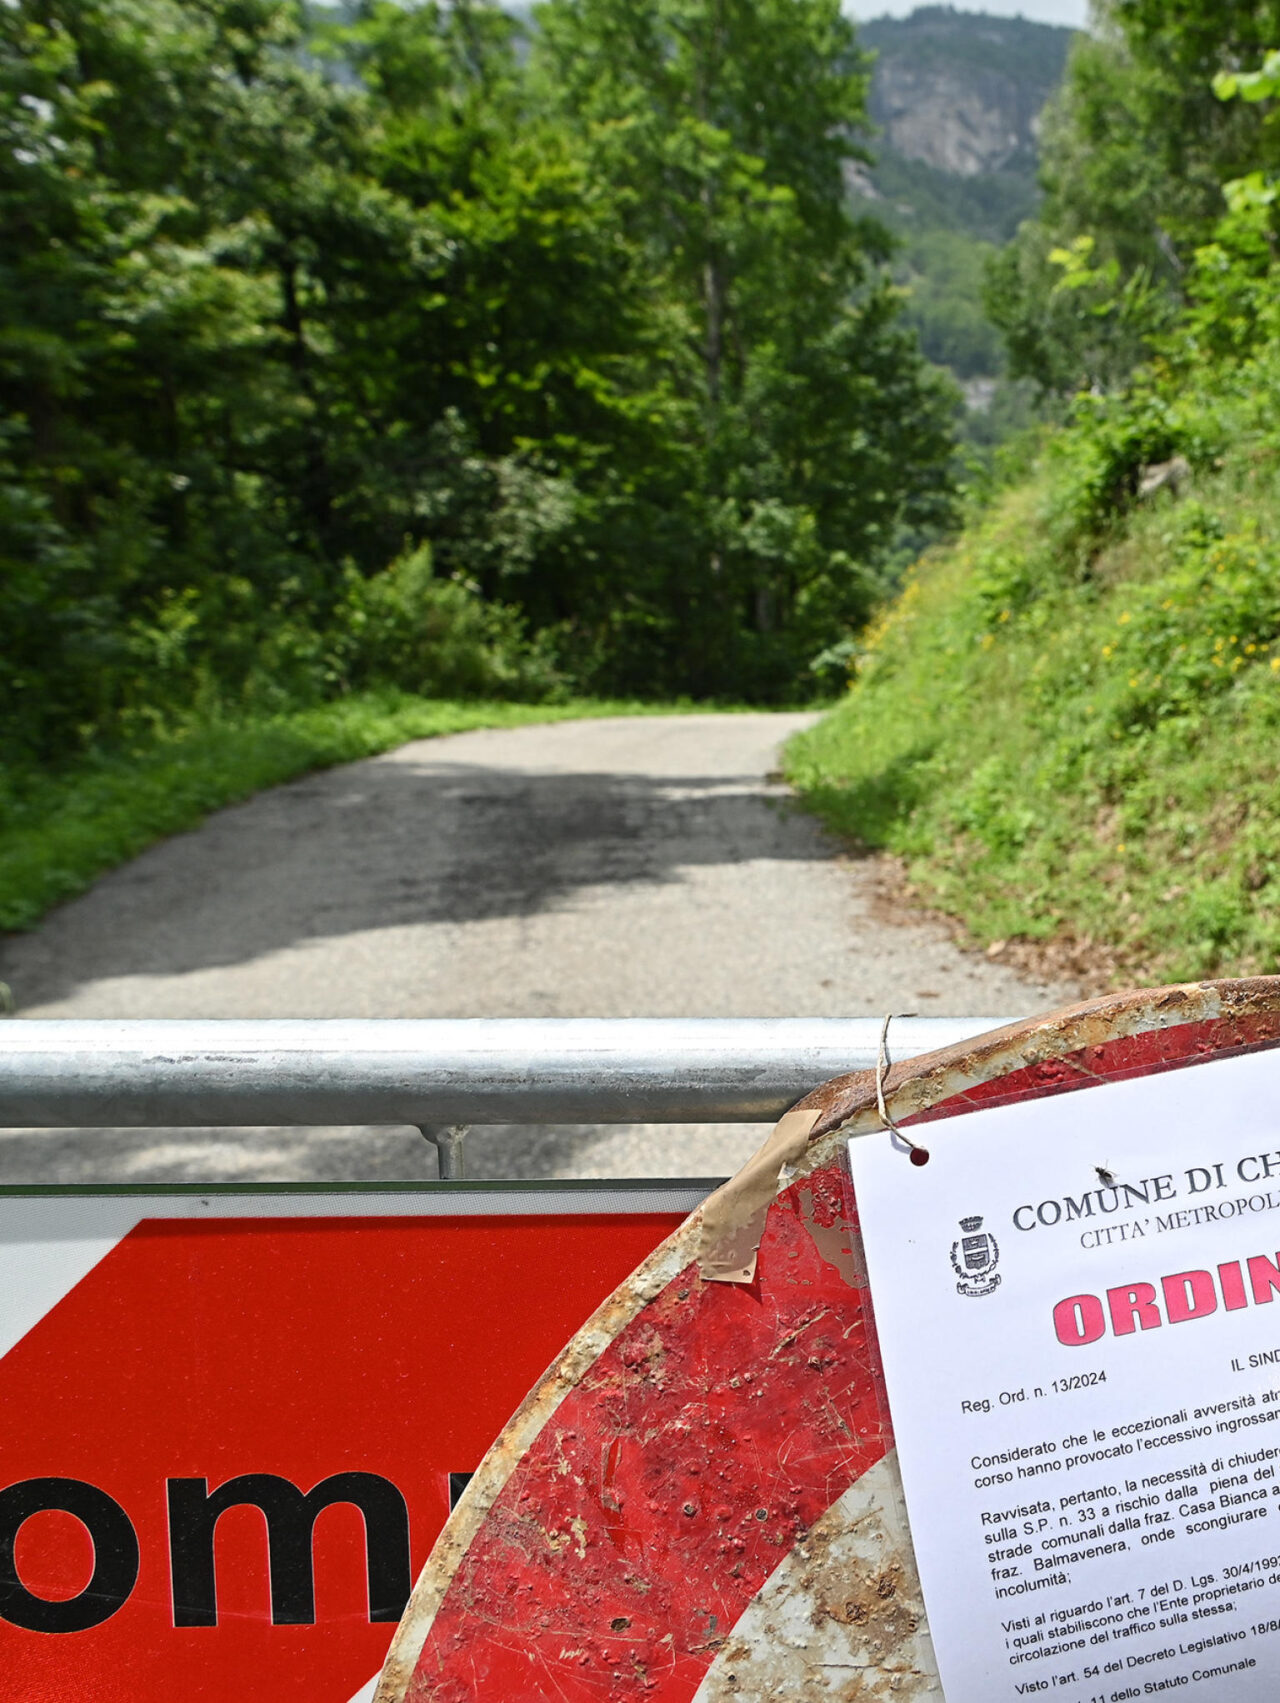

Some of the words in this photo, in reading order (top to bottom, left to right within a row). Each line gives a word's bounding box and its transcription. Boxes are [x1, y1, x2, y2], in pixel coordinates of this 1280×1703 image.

[1011, 1173, 1178, 1232] COMUNE
[1183, 1162, 1229, 1195] DI
[959, 1397, 996, 1415] Reg.
[997, 1386, 1030, 1406] Ord.
[1050, 1368, 1108, 1394] 13/2024
[1229, 1357, 1246, 1373] IL
[969, 1440, 1058, 1471] Considerato
[1060, 1433, 1089, 1450] che
[1110, 1407, 1189, 1439] eccezionali
[1192, 1392, 1257, 1420] avversità
[973, 1470, 1014, 1490] corso
[1015, 1458, 1063, 1480] hanno
[1063, 1441, 1134, 1472] provocato
[1135, 1424, 1213, 1452] l'eccessivo
[979, 1499, 1056, 1527] Ravvisata,
[1058, 1484, 1122, 1512] pertanto,
[1140, 1460, 1208, 1489] necessità
[983, 1525, 1019, 1546] sulla
[1021, 1516, 1054, 1536] S.P.
[1076, 1506, 1097, 1524] 33
[1114, 1492, 1161, 1515] rischio
[1163, 1483, 1199, 1503] dalla
[1208, 1473, 1249, 1495] piena
[1252, 1463, 1276, 1482] del
[986, 1541, 1034, 1564] strade
[1039, 1522, 1106, 1551] comunali
[1106, 1515, 1142, 1535] dalla
[1142, 1510, 1175, 1527] fraz.
[1177, 1499, 1217, 1518] Casa
[1217, 1487, 1269, 1509] Bianca
[0, 1471, 474, 1634] om
[989, 1565, 1024, 1582] fraz.
[1031, 1539, 1132, 1572] Balmavenera,
[1139, 1526, 1176, 1546] onde
[1184, 1506, 1268, 1536] scongiurare
[993, 1570, 1072, 1600] incolumità;
[999, 1614, 1031, 1634] Visti
[1048, 1599, 1104, 1624] riguardo
[1105, 1591, 1135, 1609] l'art.
[1149, 1581, 1170, 1598] del
[1171, 1578, 1188, 1593] D.
[1189, 1572, 1219, 1589] Lgs.
[1011, 1628, 1045, 1650] quali
[1046, 1611, 1125, 1640] stabiliscono
[1125, 1605, 1151, 1620] che
[1151, 1595, 1190, 1614] l'Ente
[1191, 1576, 1266, 1607] proprietario
[1008, 1637, 1087, 1666] circolazione
[1088, 1629, 1110, 1646] del
[1110, 1620, 1157, 1640] traffico
[1158, 1611, 1189, 1629] sulla
[1190, 1600, 1238, 1621] stessa;
[1013, 1679, 1050, 1696] Visto
[1050, 1670, 1080, 1688] l'art.
[1082, 1663, 1101, 1680] 54
[1102, 1657, 1124, 1675] del
[1125, 1647, 1177, 1669] Decreto
[1177, 1629, 1247, 1655] Legislativo
[1109, 1686, 1142, 1703] dello
[1142, 1674, 1190, 1695] Statuto
[1190, 1656, 1257, 1682] Comunale
